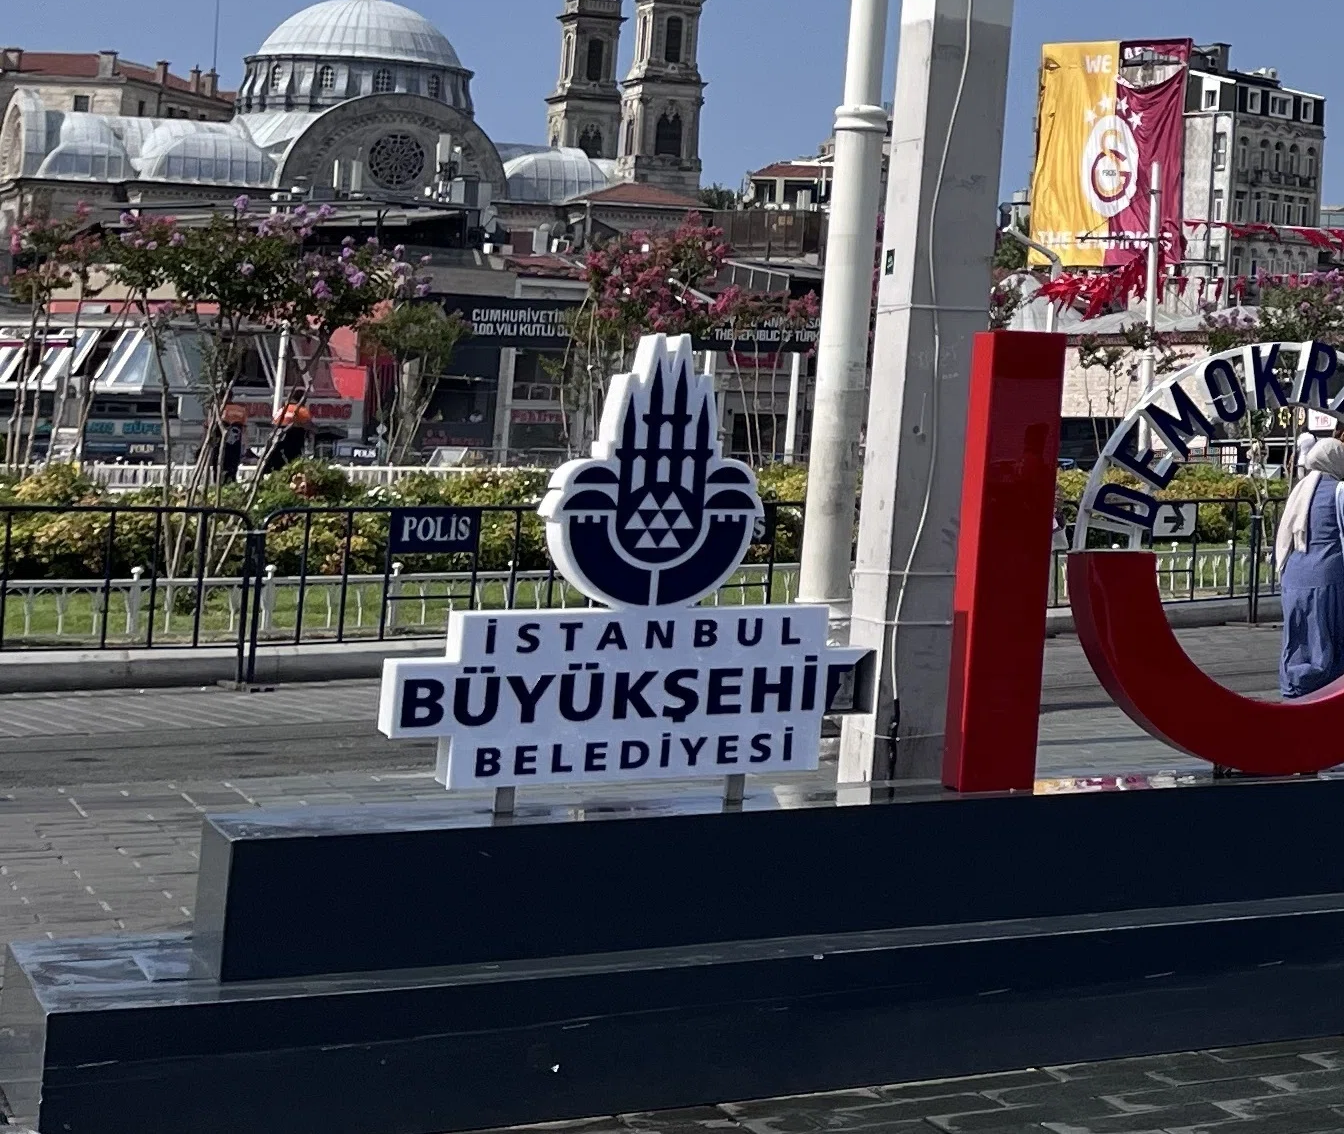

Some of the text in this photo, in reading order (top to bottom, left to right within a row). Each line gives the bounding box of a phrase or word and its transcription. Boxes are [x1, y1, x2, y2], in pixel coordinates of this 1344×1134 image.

[1085, 54, 1113, 74] WE
[1038, 230, 1073, 249] THE
[519, 323, 553, 337] KUTLU
[795, 327, 820, 341] TÜRK
[401, 513, 471, 542] POLİS
[485, 617, 801, 654] İSTANBUL
[475, 727, 794, 778] BELEDİYESİ
